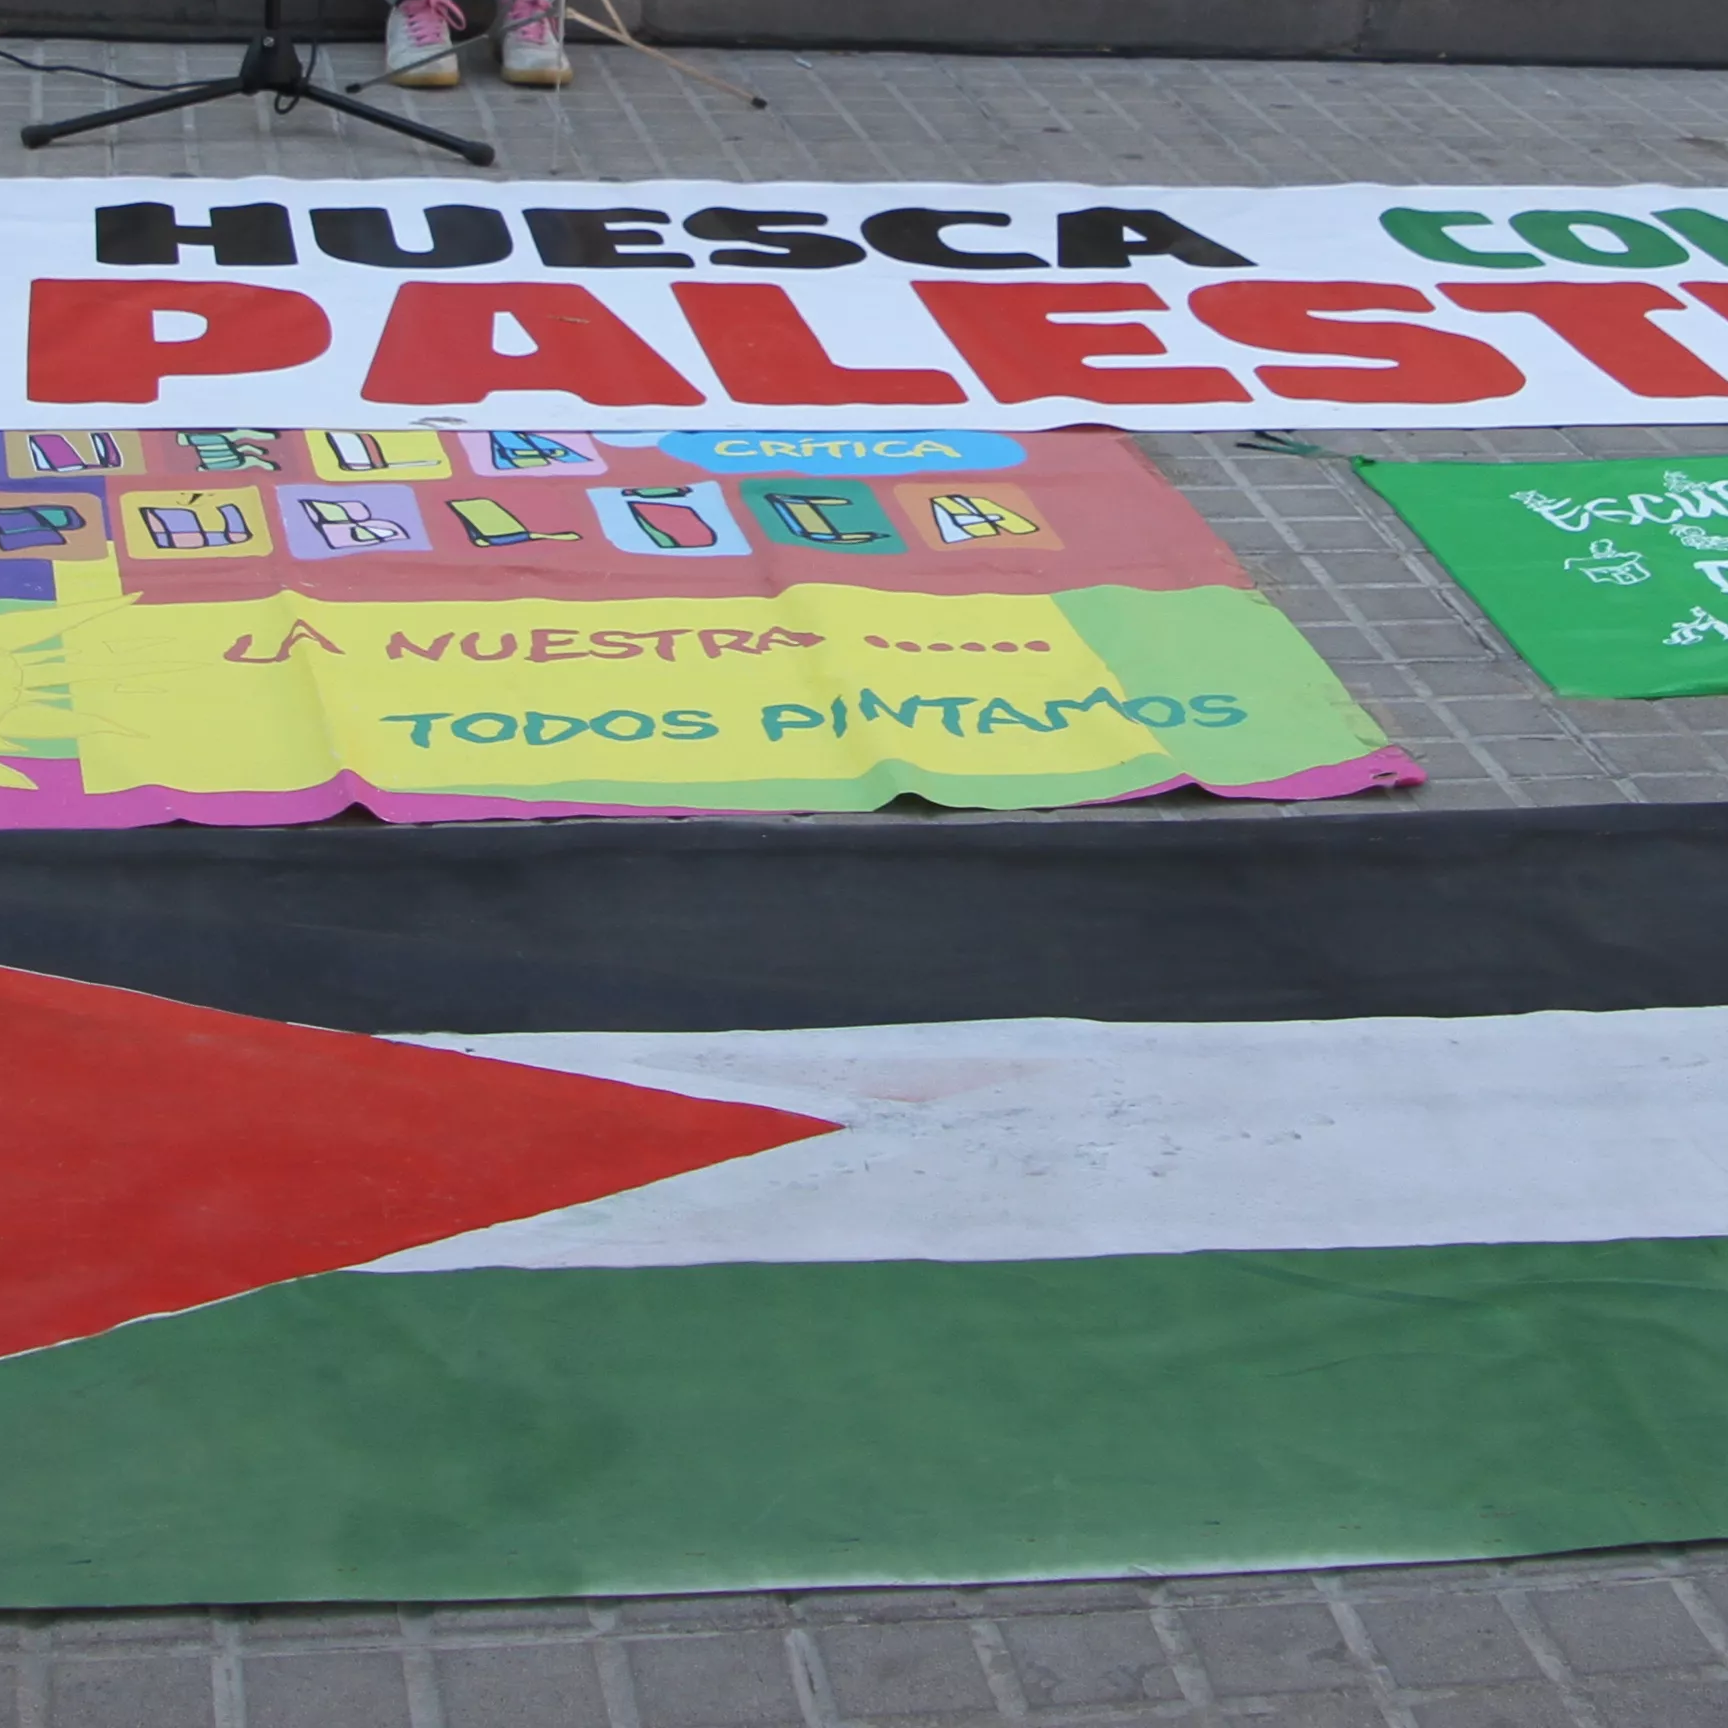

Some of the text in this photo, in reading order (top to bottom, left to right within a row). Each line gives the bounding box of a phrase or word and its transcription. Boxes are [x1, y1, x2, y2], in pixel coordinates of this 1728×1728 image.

[94, 201, 1258, 271] HUESCA
[712, 437, 963, 460] CRÍTICA
[221, 618, 346, 664] LA
[384, 627, 825, 663] NUESTRA
[379, 687, 1248, 751] TODOS PINTAMOS
